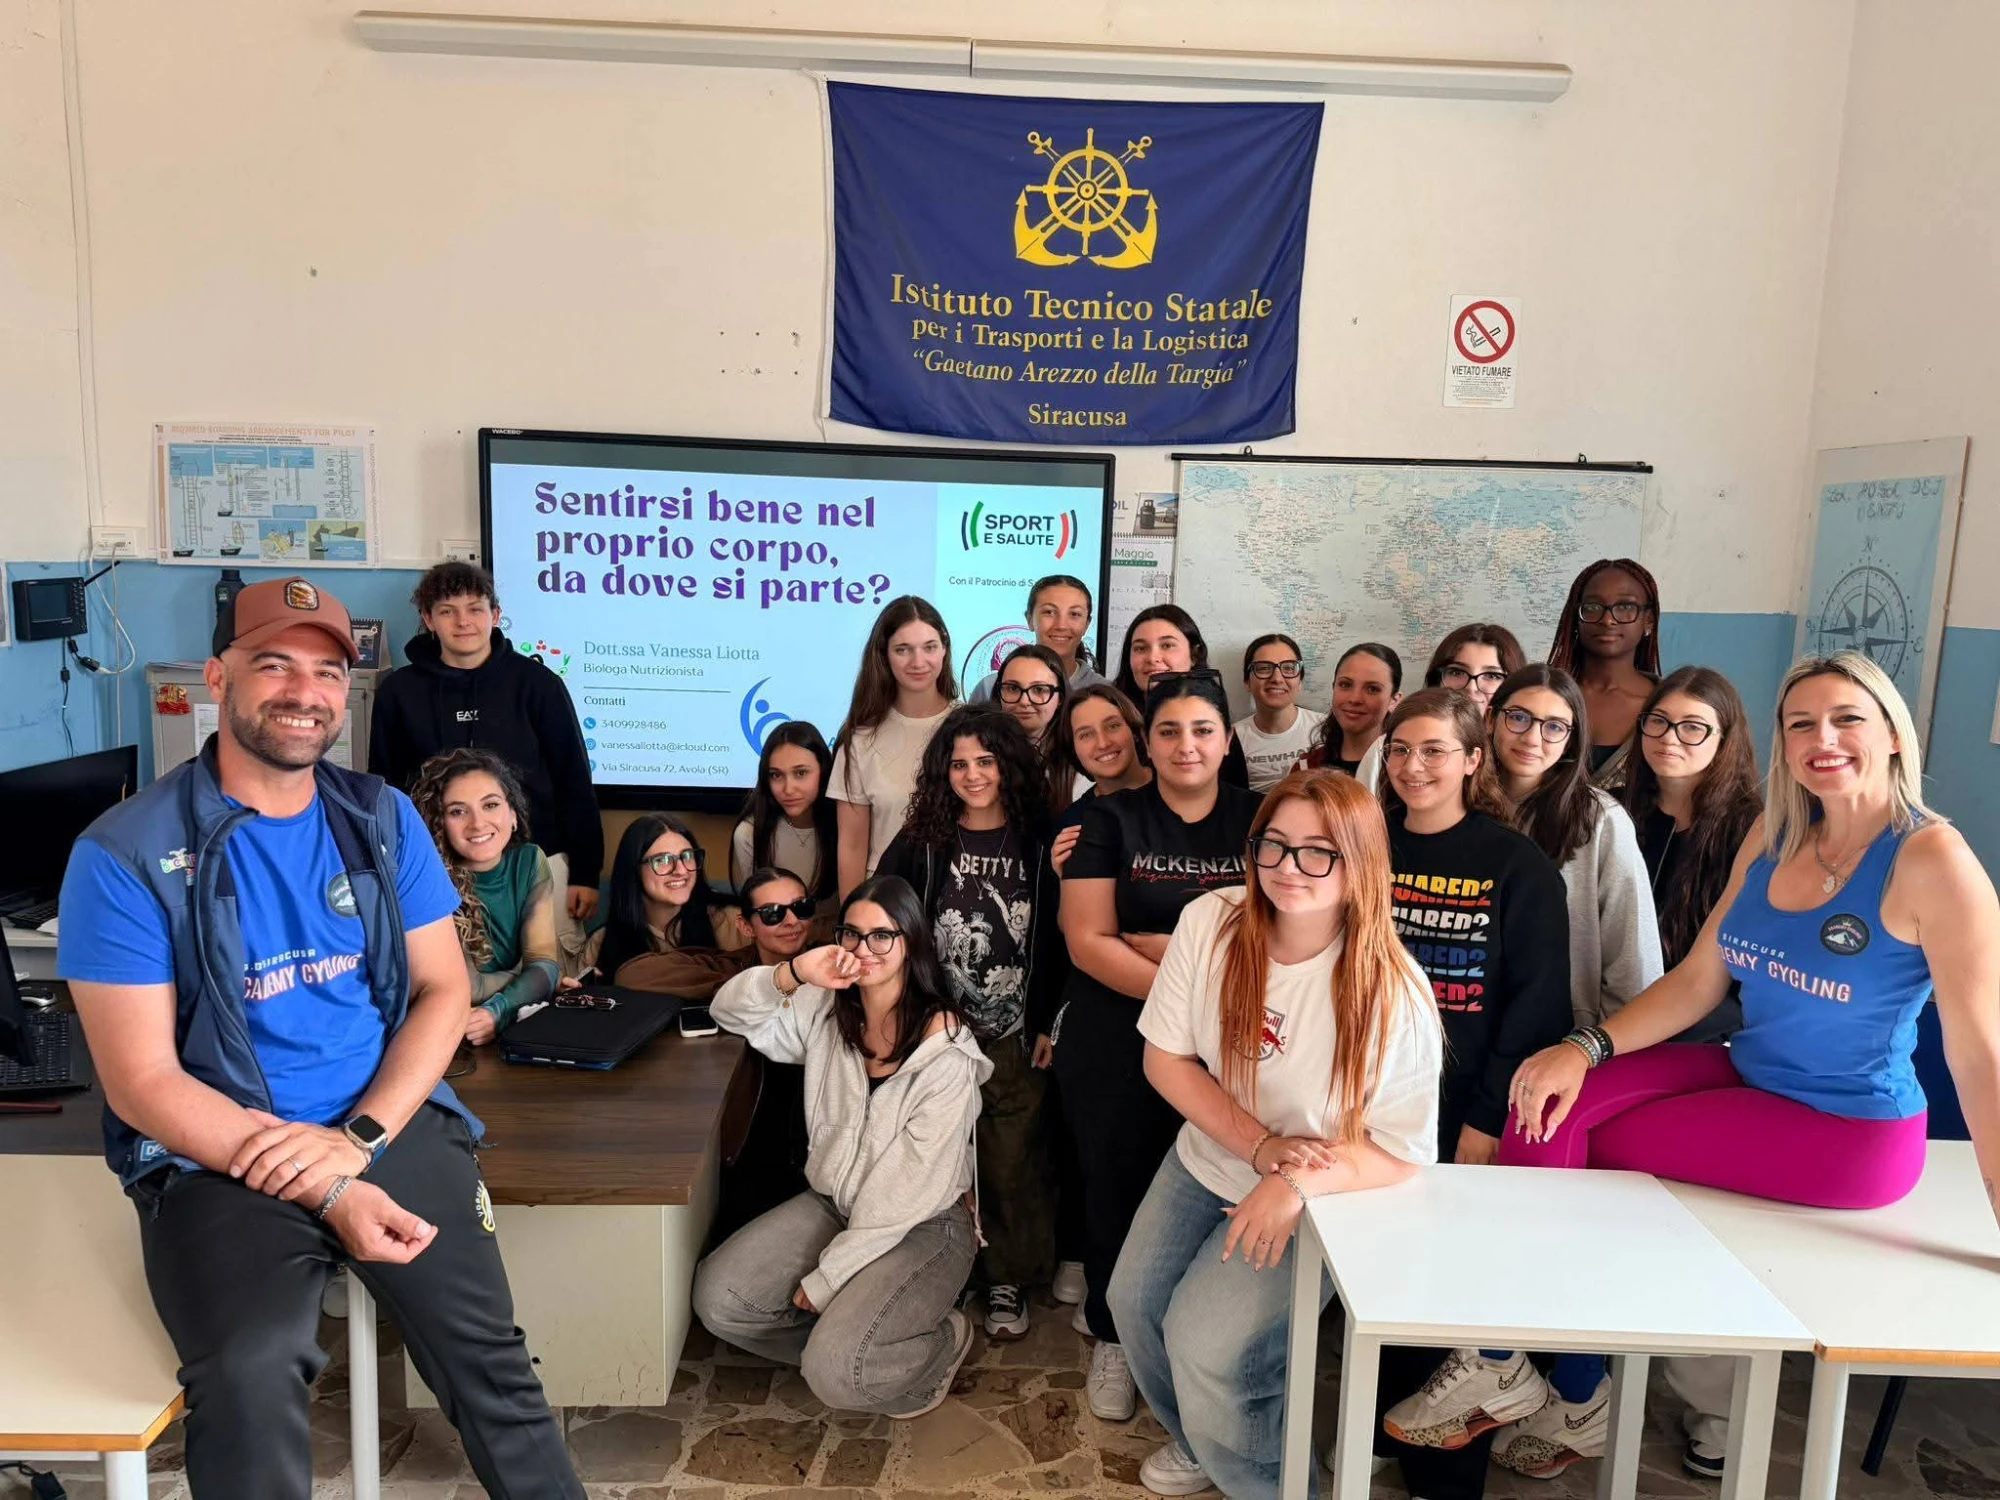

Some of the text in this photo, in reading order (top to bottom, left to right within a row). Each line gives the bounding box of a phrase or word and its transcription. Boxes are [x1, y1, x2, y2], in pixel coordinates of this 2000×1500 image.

[891, 274, 1272, 321] Istituto Tecnico Statale
[912, 317, 1249, 357] per i Trasporti e la Logistica
[1019, 361, 1096, 384] Arezzo
[1104, 362, 1156, 385] della
[1452, 365, 1512, 377] VIETATO FUMARE
[1028, 403, 1127, 427] Siracusa
[315, 428, 330, 437] FOR
[333, 429, 356, 437] PILOT
[535, 481, 875, 528] Sentirsi bene nel
[985, 514, 1055, 531] SPORT
[536, 526, 839, 570] proprio corpo,
[984, 533, 1055, 546] E SALUTE
[1115, 548, 1154, 559] Maggio
[537, 562, 891, 609] da dove si parte?
[949, 576, 966, 586] Con
[968, 577, 973, 586] il
[976, 577, 1016, 587] Patrocinio
[1018, 578, 1026, 587] di
[584, 641, 760, 660] Dott.ssa Vanessa Liotta
[584, 663, 704, 677] Biologa Nutrizionista
[584, 695, 626, 706] Contatti
[601, 719, 666, 730] 3409928486
[601, 763, 617, 772] Via
[619, 763, 661, 773] Siracusa
[679, 765, 705, 774] Avola
[708, 764, 729, 776] (SR)
[960, 853, 1013, 878] BETTY
[1722, 933, 1785, 959] SIRACUSA
[1768, 961, 1851, 1003] CYCLING
